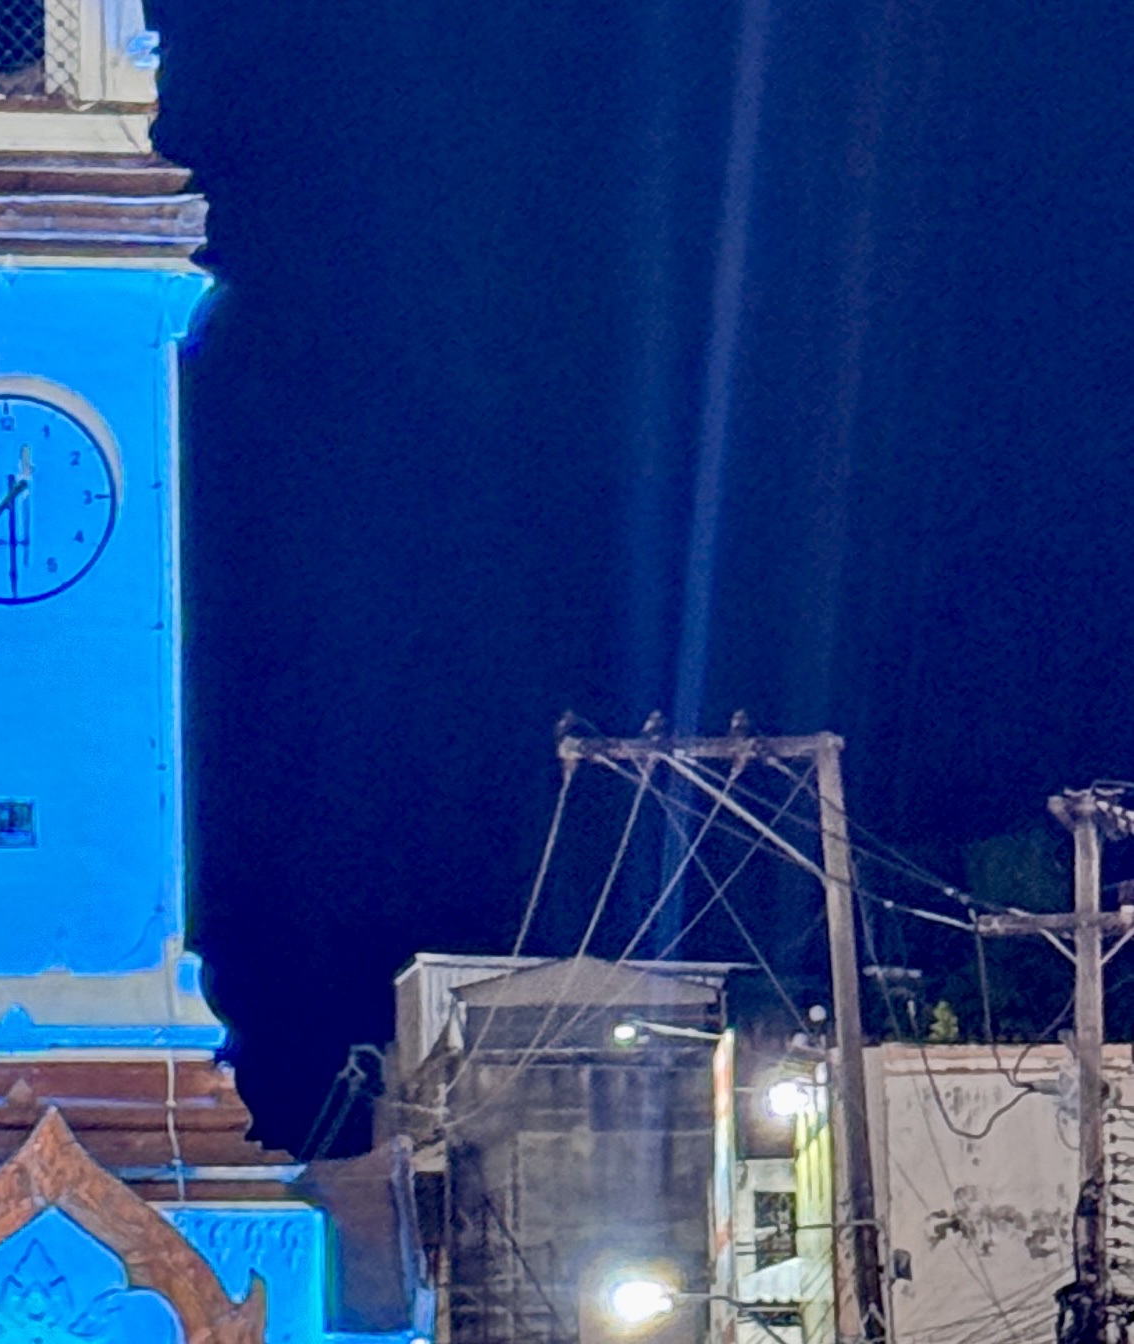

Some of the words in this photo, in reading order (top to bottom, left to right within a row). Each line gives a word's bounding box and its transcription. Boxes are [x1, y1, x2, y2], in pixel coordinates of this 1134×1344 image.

[42, 426, 50, 438] 1
[70, 452, 80, 466] 2
[74, 531, 84, 542] 4
